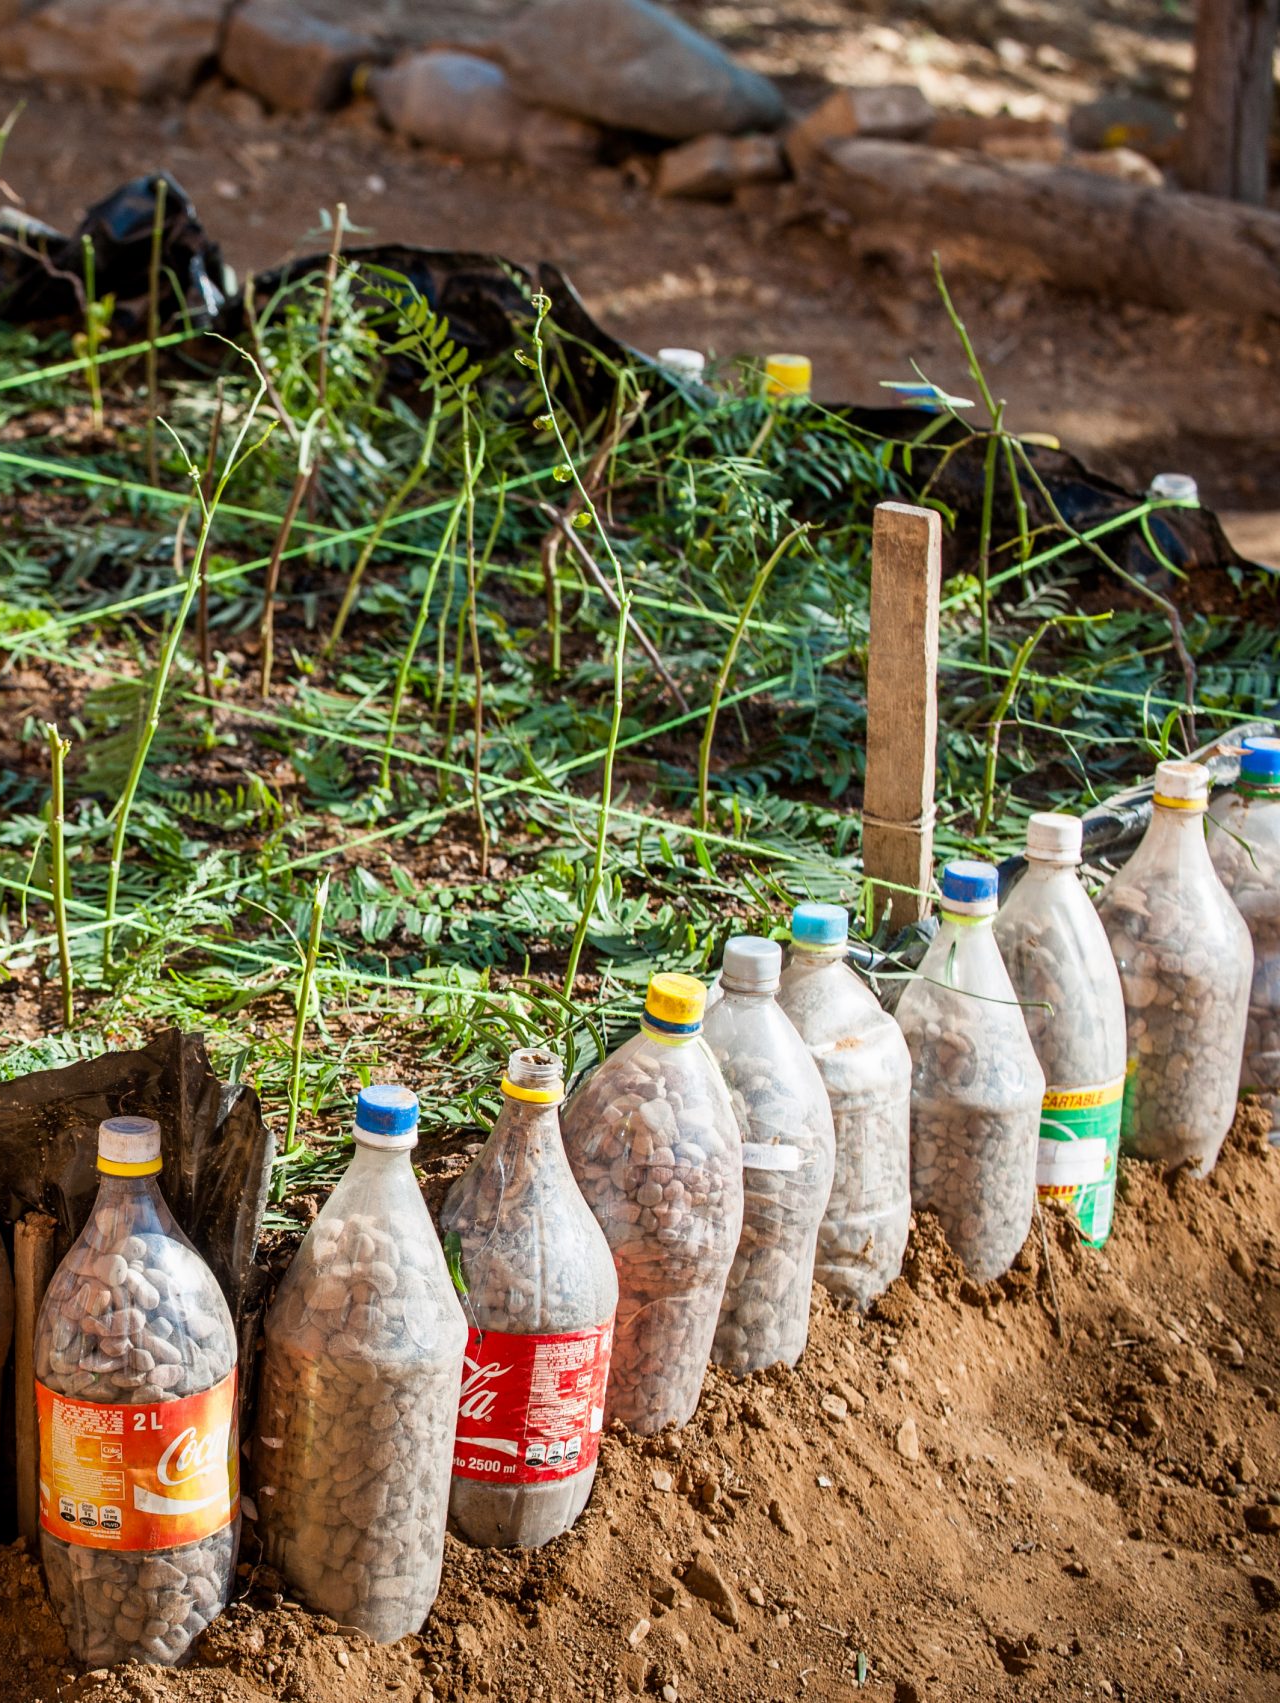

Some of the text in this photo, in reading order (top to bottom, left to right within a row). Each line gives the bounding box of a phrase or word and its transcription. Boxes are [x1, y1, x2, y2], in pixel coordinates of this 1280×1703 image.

[133, 1413, 146, 1431] 2
[151, 1412, 163, 1430] L
[453, 1457, 517, 1473] to 2500 ml
